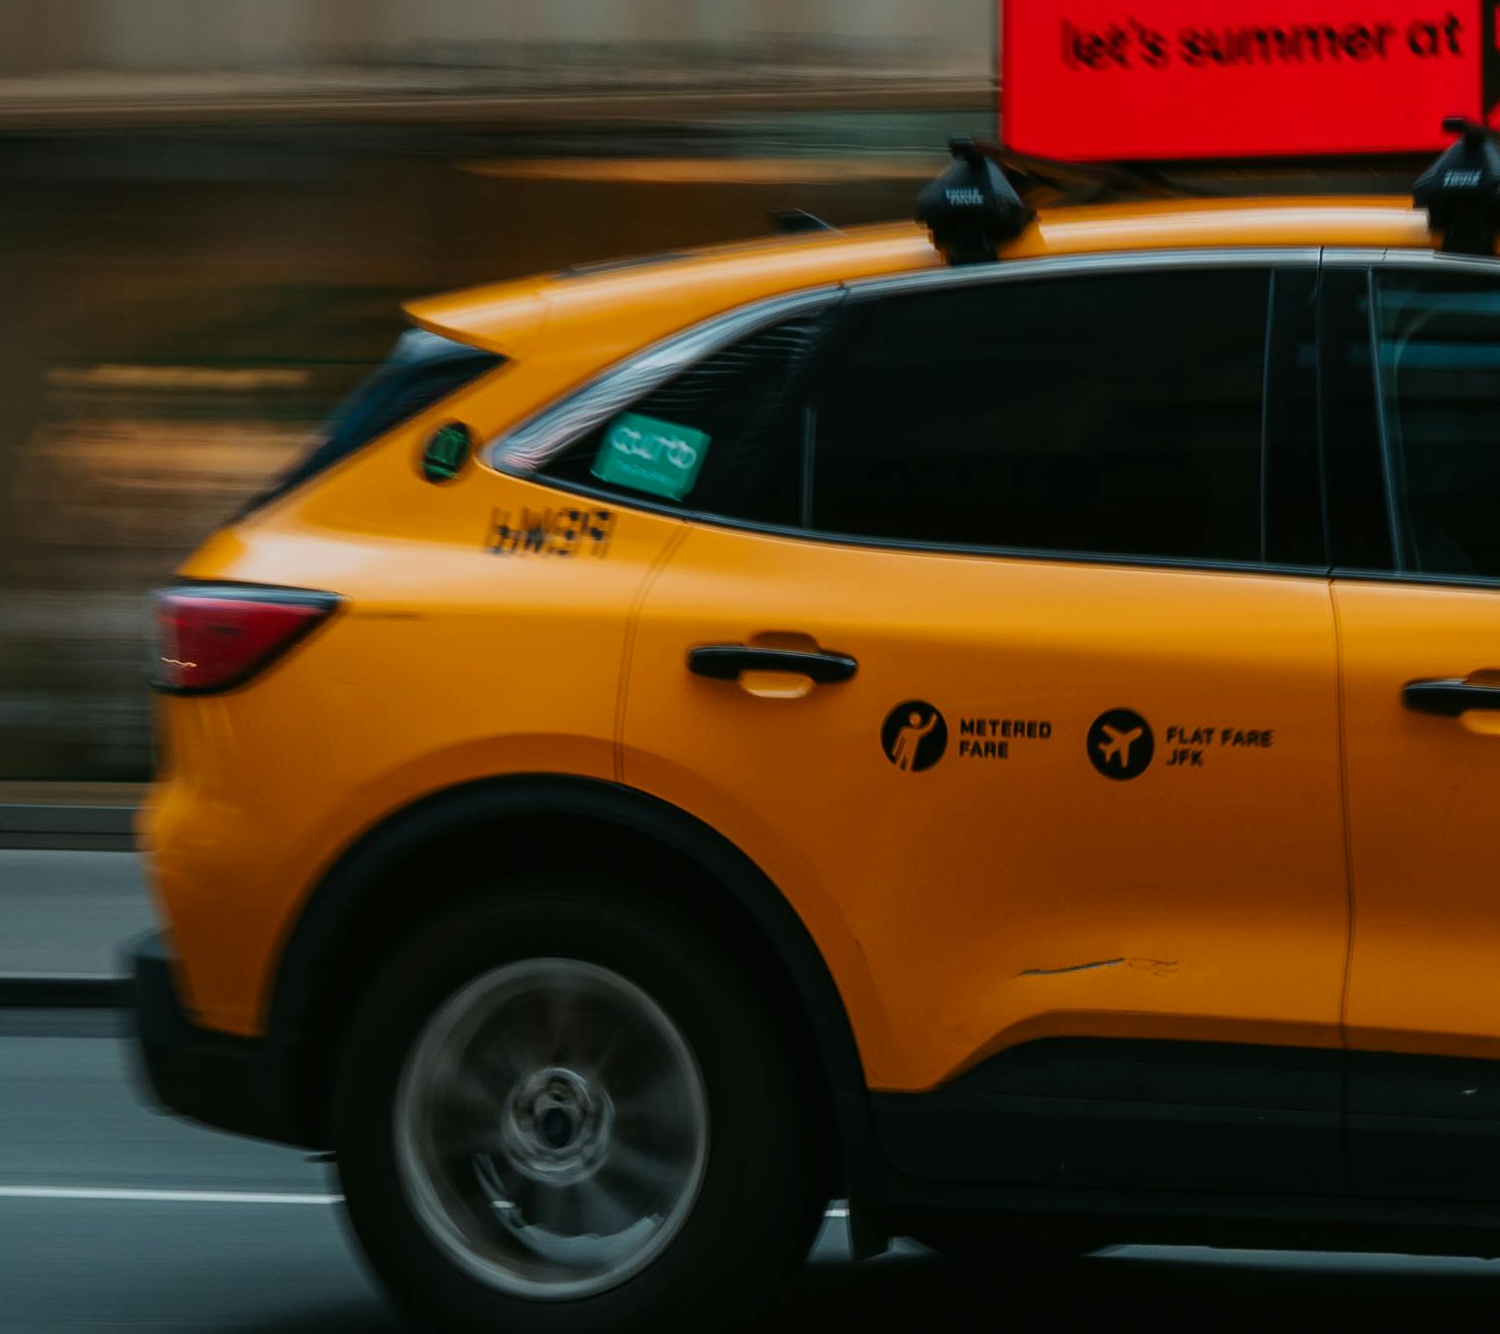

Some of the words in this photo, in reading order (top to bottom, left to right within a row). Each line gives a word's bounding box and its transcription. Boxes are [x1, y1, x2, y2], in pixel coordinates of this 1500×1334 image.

[1062, 17, 1168, 71] let's
[1179, 20, 1395, 68] summer
[1406, 10, 1462, 58] at
[959, 718, 1052, 741] METERED
[1166, 726, 1215, 747] FLAT
[1220, 728, 1275, 750] FARE
[959, 740, 1009, 760] FARE
[1165, 748, 1205, 768] JFK
